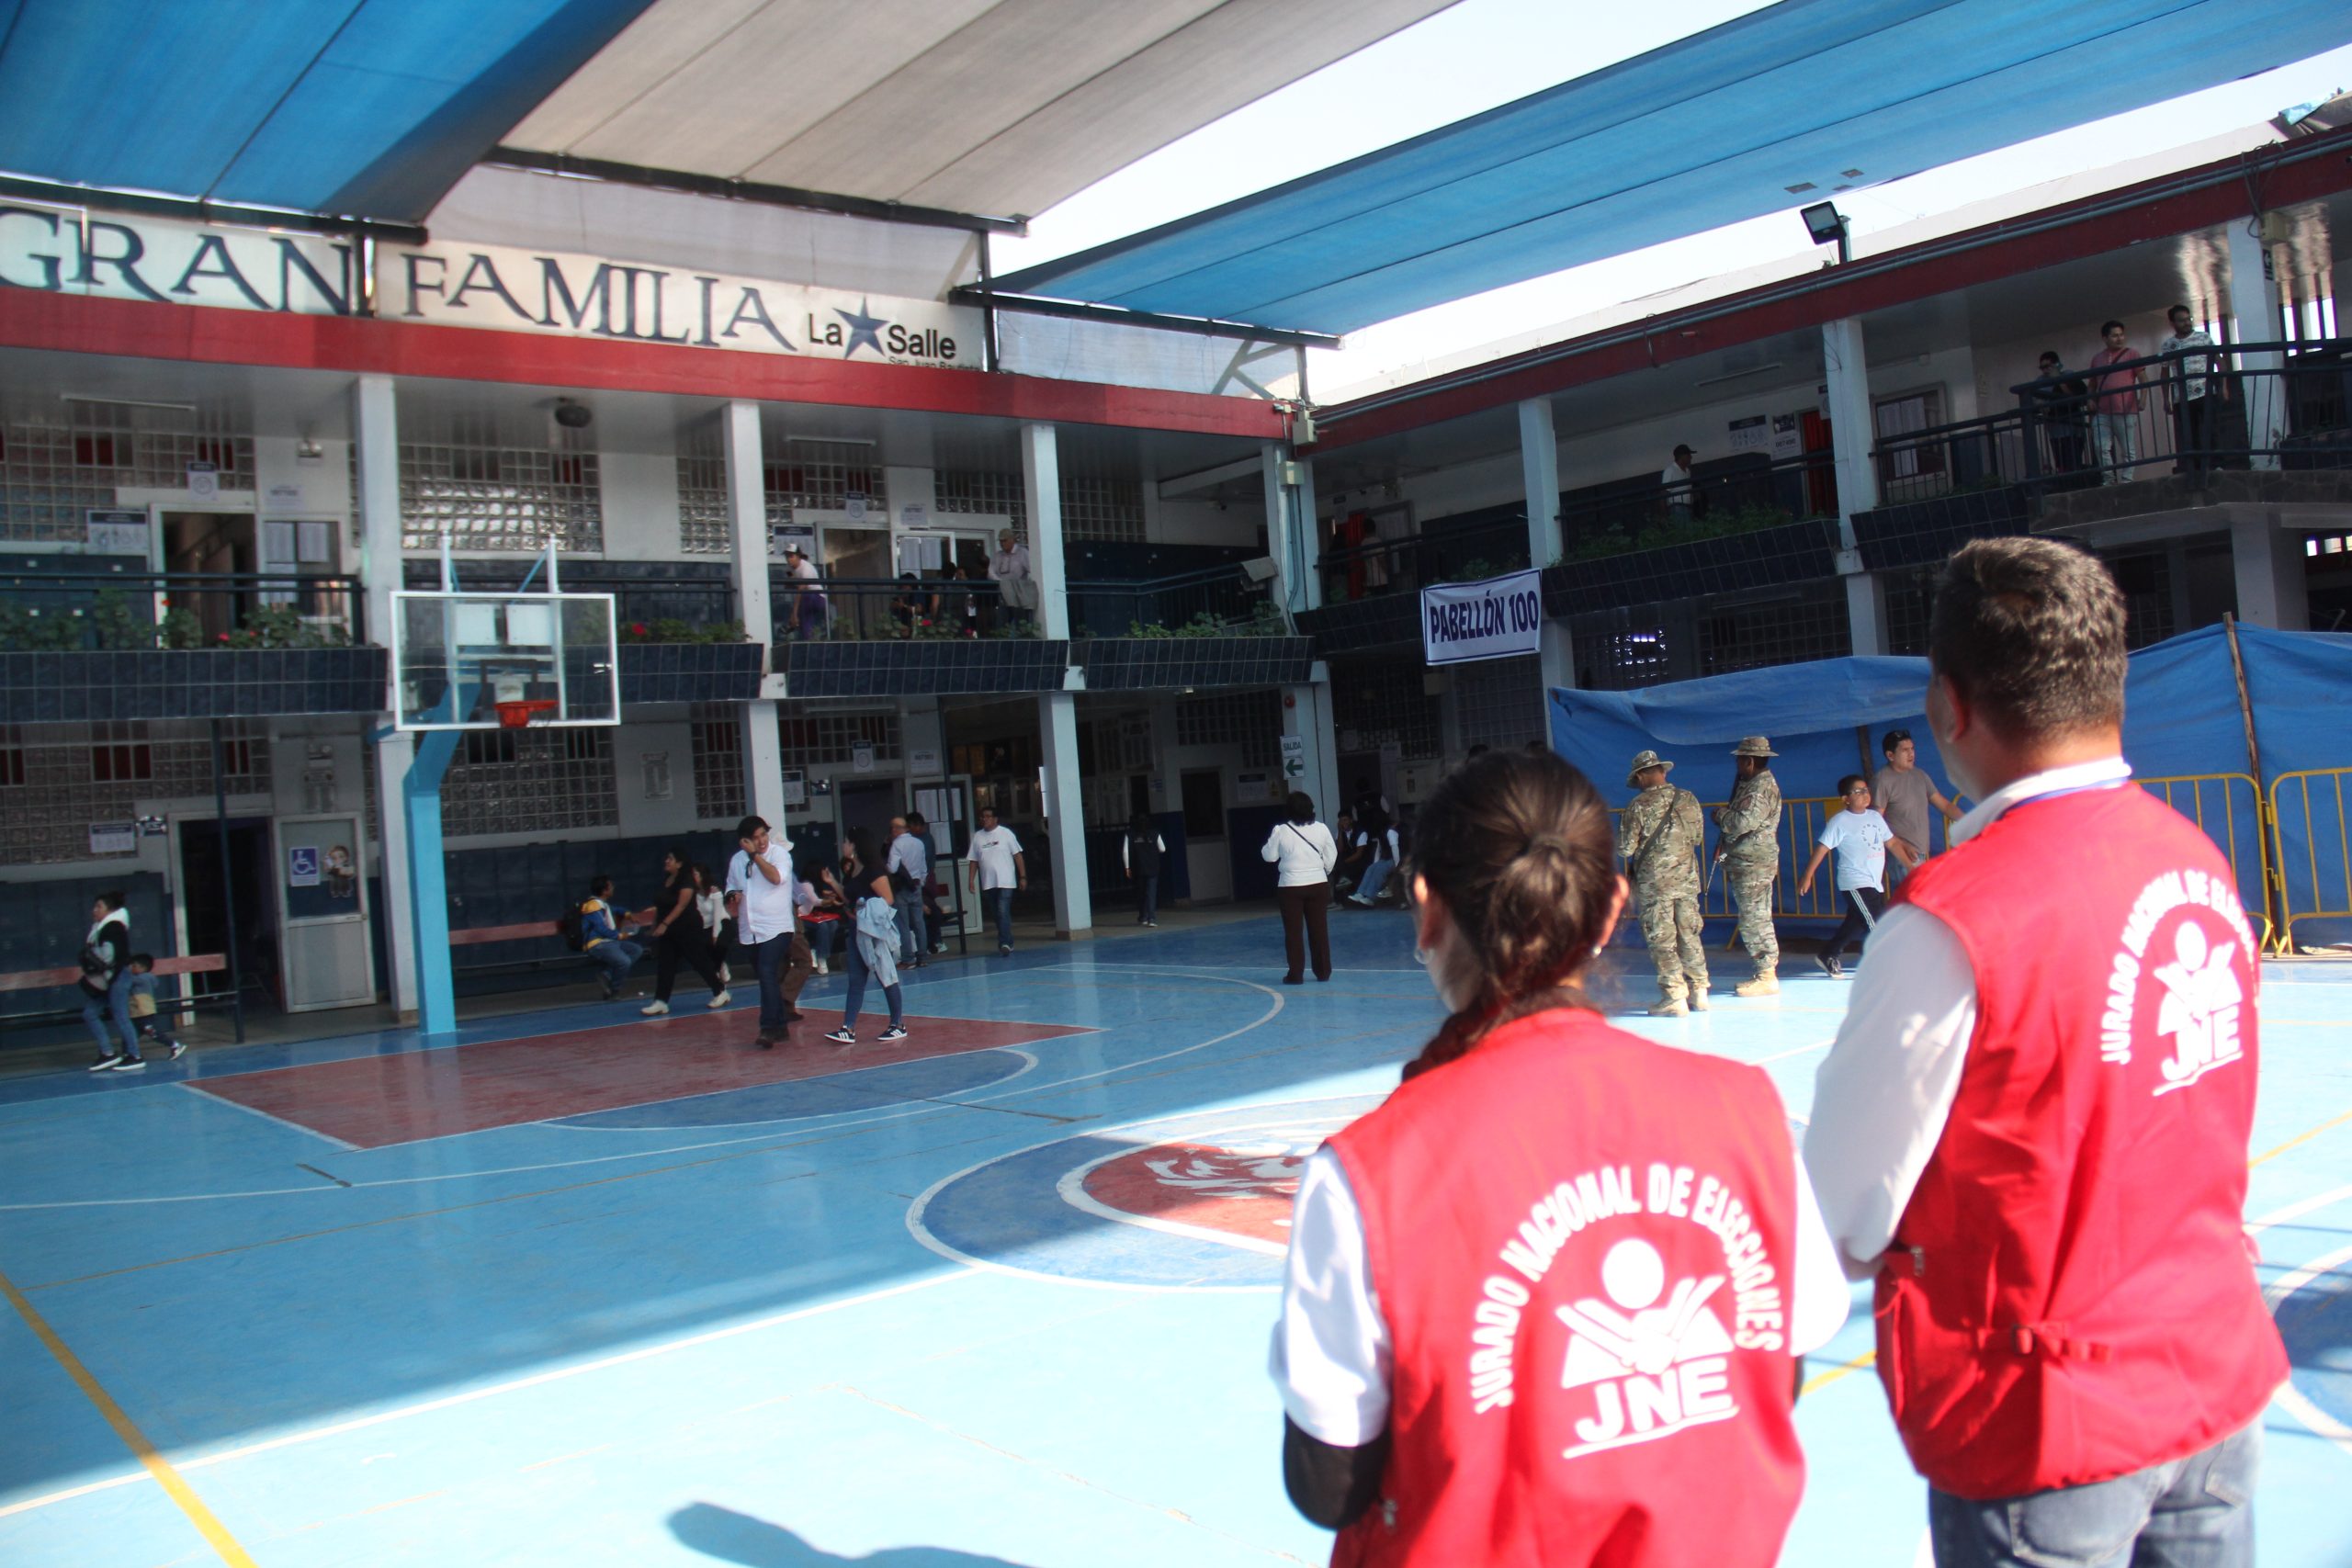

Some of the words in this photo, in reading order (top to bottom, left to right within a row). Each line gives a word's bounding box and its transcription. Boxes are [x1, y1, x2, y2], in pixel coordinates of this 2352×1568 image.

[0, 206, 352, 316] GRAN
[399, 252, 798, 353] FAMILIA
[808, 312, 843, 347] La
[887, 324, 956, 359] Salle
[1430, 589, 1506, 644] PABELLÓN
[1509, 591, 1539, 633] 100
[1283, 741, 1302, 751] SALIDA
[2100, 953, 2141, 1066] JURADO
[2161, 1004, 2241, 1082] JNE
[1498, 1165, 1643, 1283] NACIONAL
[1647, 1162, 1695, 1219] DE
[1690, 1175, 1785, 1351] ELECCIONES
[1470, 1275, 1531, 1415] JURADO
[1574, 1356, 1735, 1444] JNE
